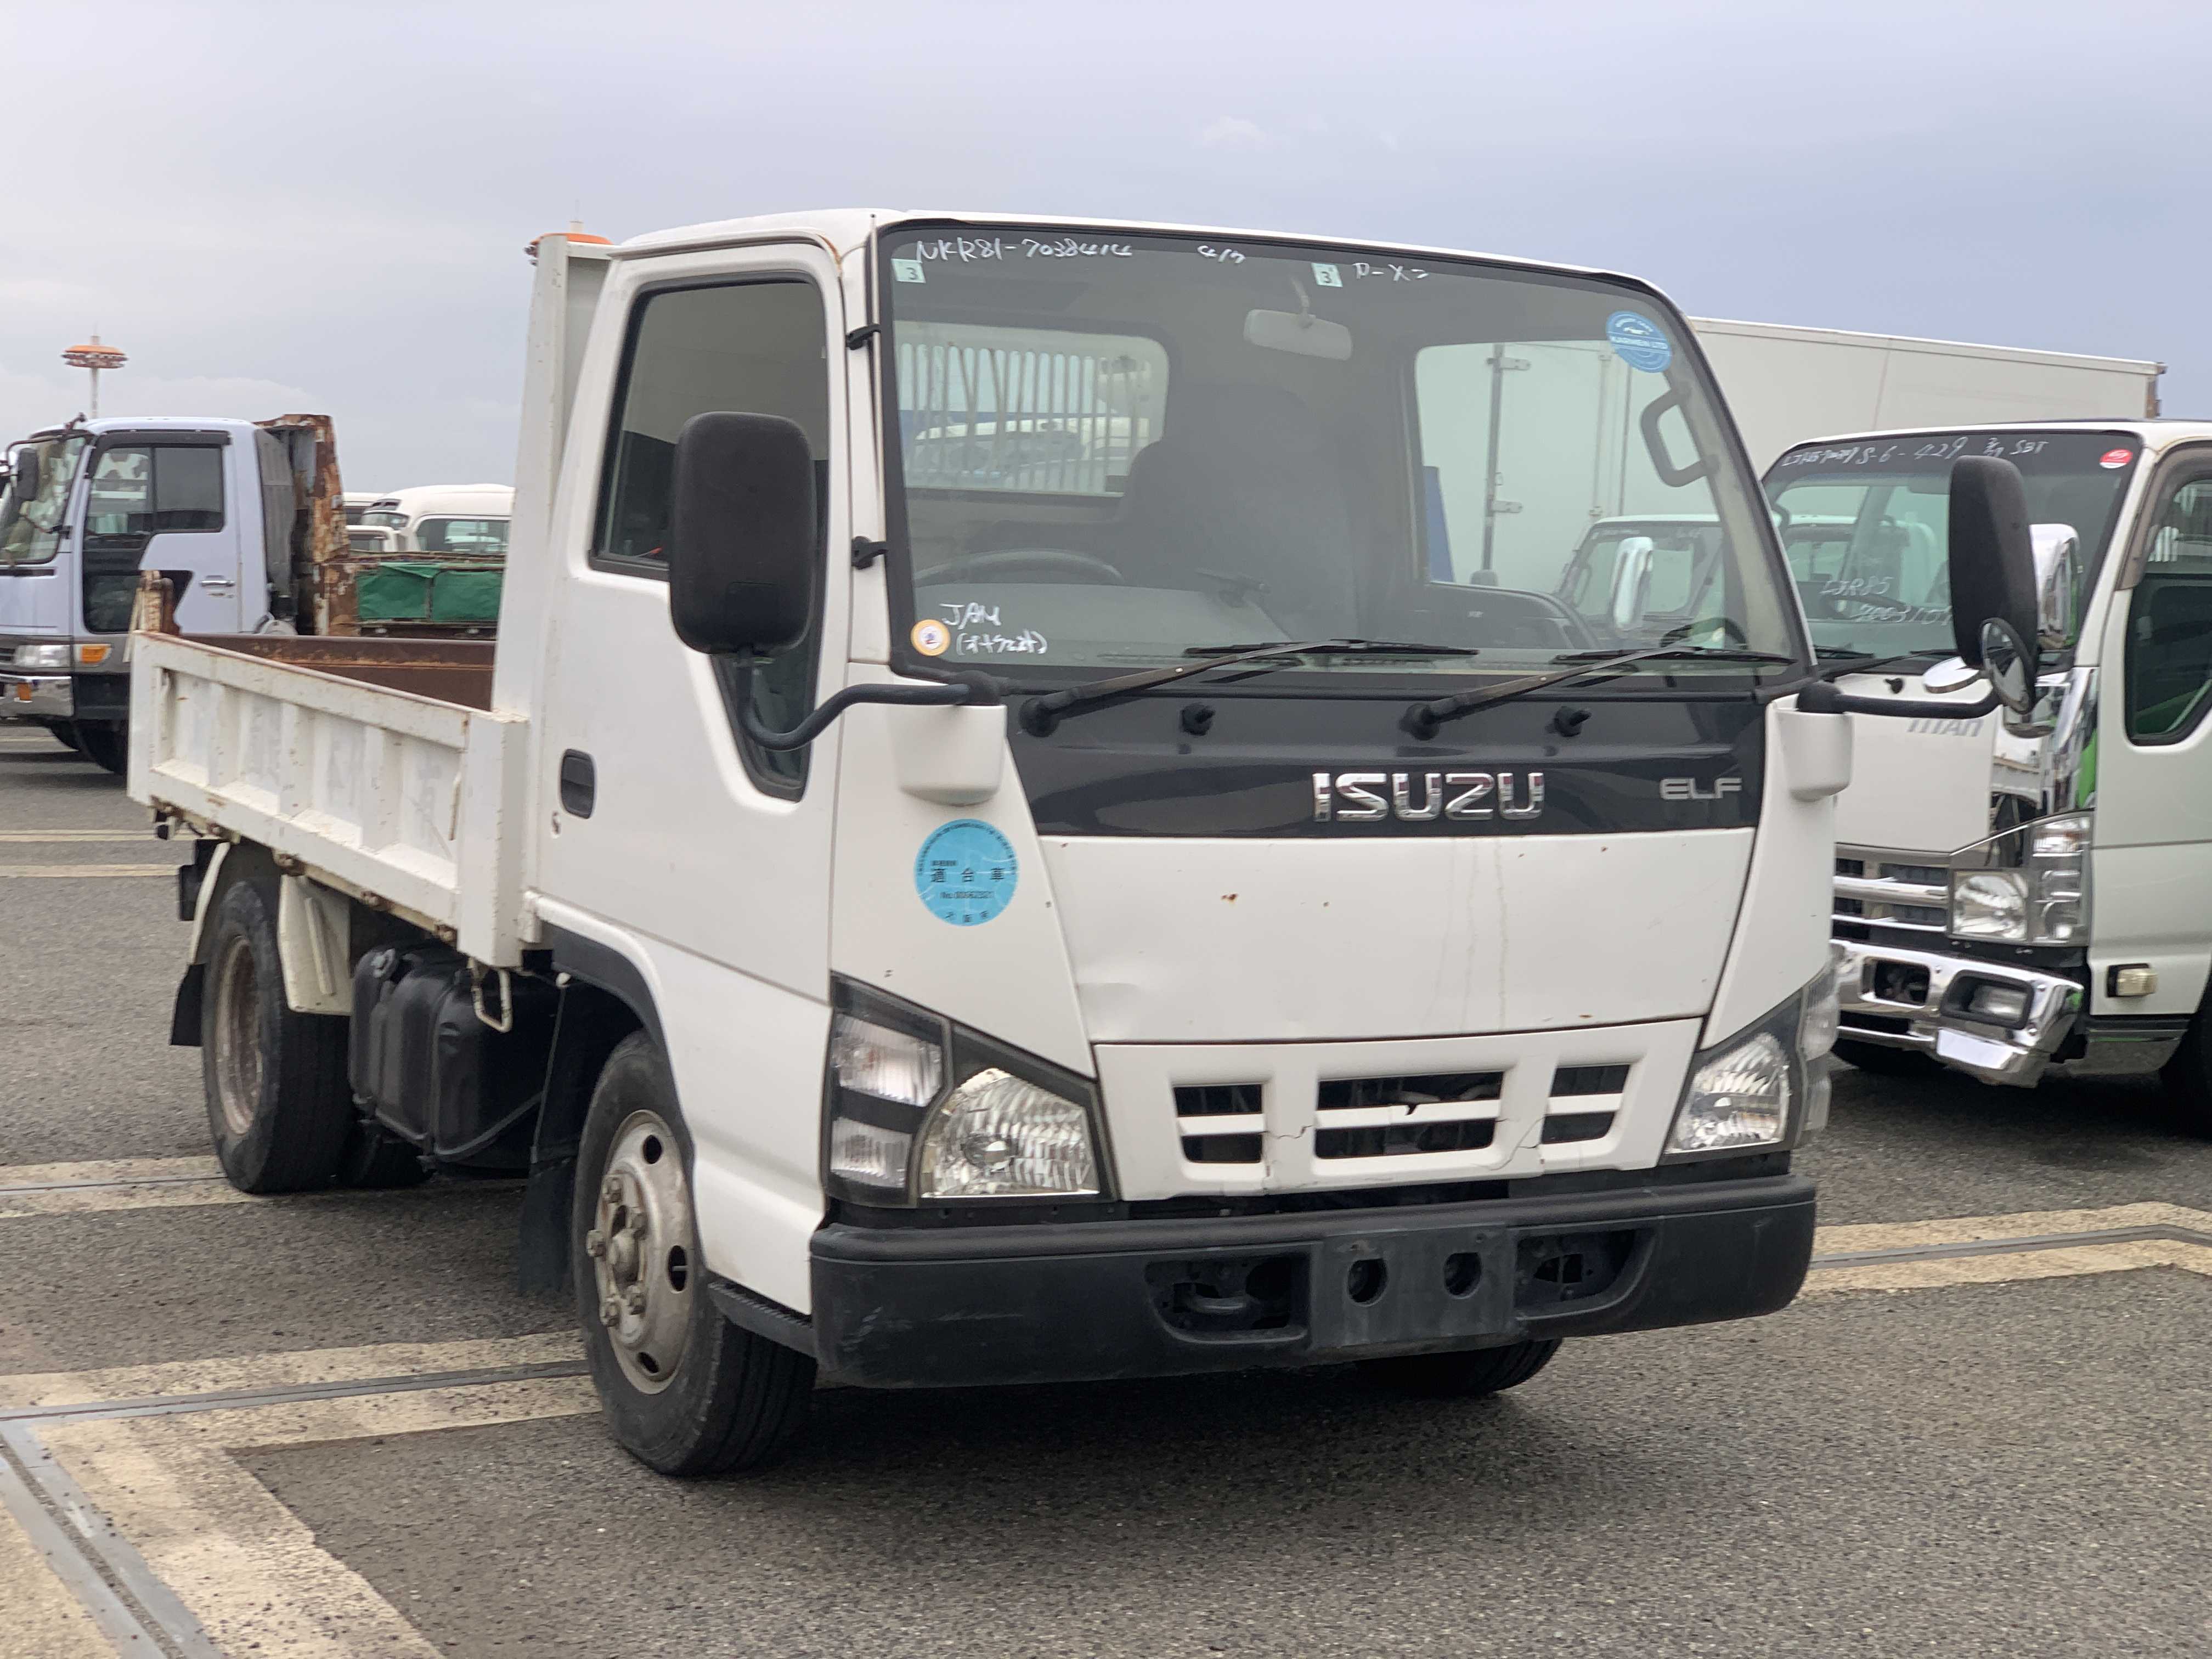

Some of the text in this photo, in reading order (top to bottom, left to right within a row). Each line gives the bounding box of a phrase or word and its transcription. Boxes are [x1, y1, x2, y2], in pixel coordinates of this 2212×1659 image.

[2009, 439, 2050, 455] SBT
[1906, 718, 1984, 737] TITAN
[1312, 771, 1546, 823] ISUZU
[1659, 777, 1743, 800] ELF
